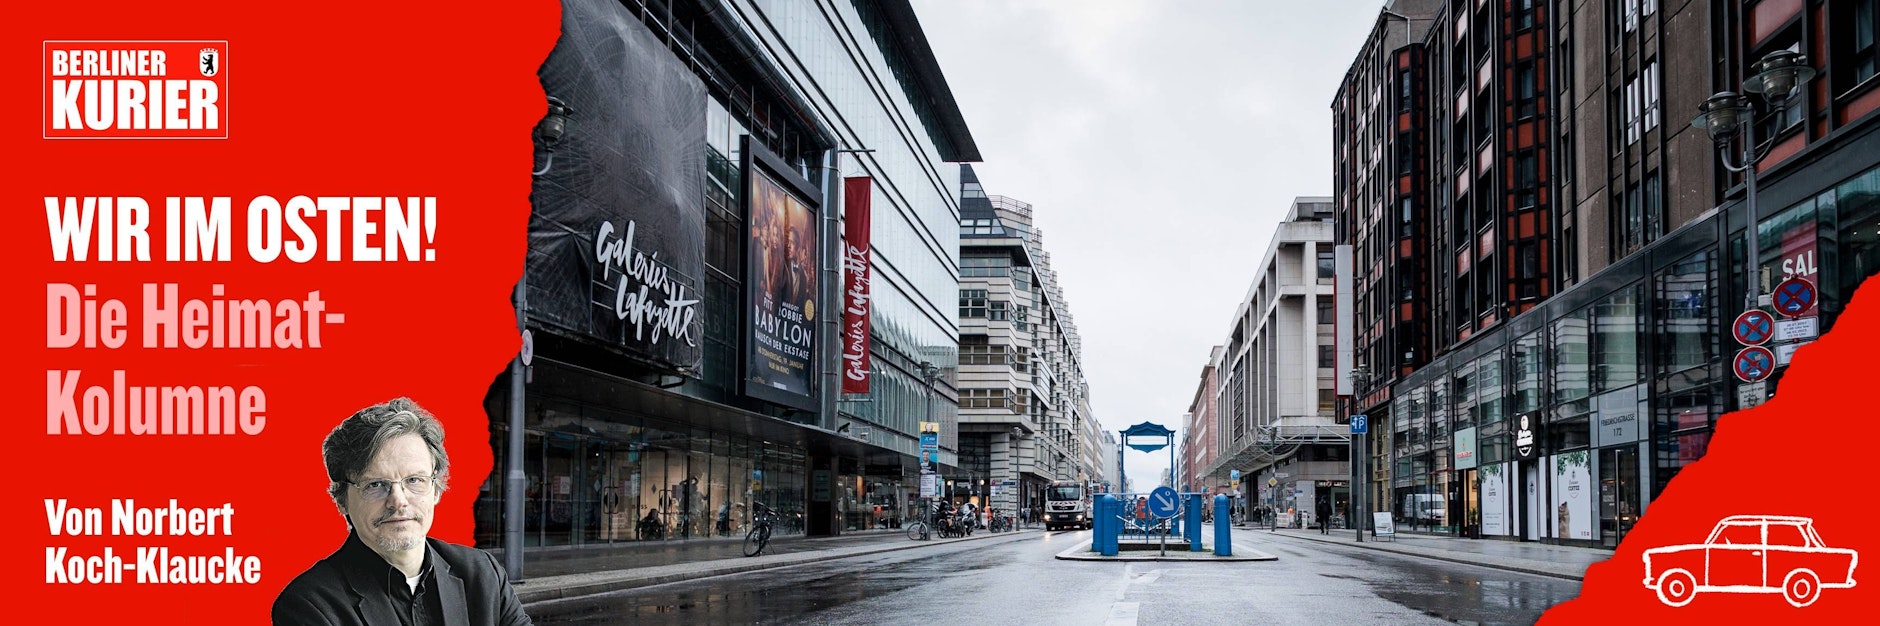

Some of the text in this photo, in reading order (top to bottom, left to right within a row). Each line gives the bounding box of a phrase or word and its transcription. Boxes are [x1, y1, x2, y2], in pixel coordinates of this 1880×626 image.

[596, 220, 670, 295] Galeries
[616, 274, 700, 347] Lafayette
[763, 297, 774, 311] PITT
[843, 241, 870, 381] Galeries Lafayette
[755, 304, 811, 348] BABYLON
[773, 339, 783, 352] DER
[784, 344, 810, 360] EKSTASE
[1601, 413, 1635, 427] FRIEDRICHSTRASSE
[1613, 428, 1622, 436] 172
